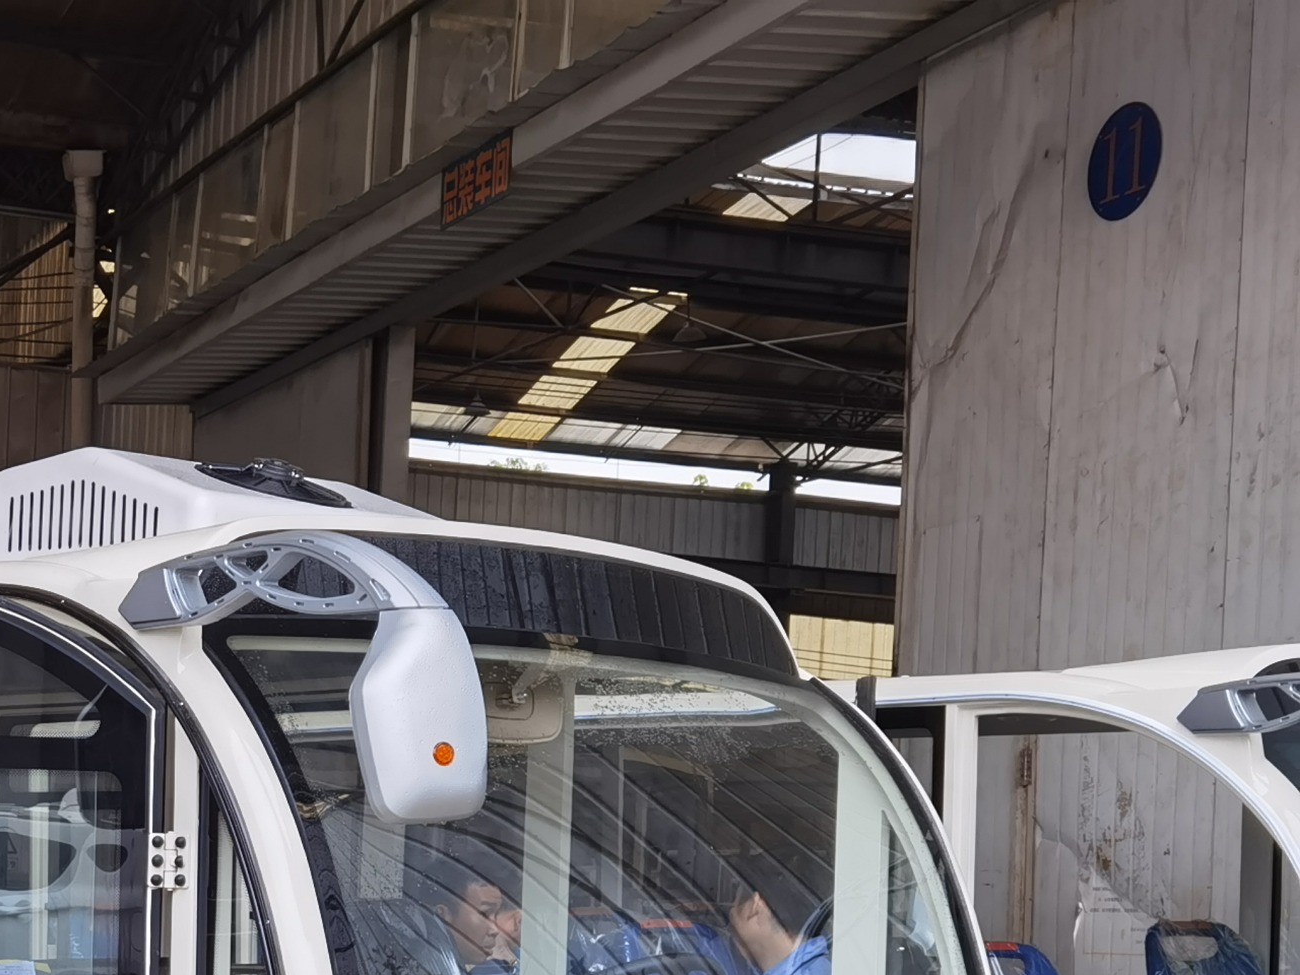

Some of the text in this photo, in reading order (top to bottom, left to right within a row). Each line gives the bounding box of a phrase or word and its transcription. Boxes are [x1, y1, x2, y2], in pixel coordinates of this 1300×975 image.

[443, 137, 510, 224] 总装车间
[1099, 116, 1147, 205] 11
